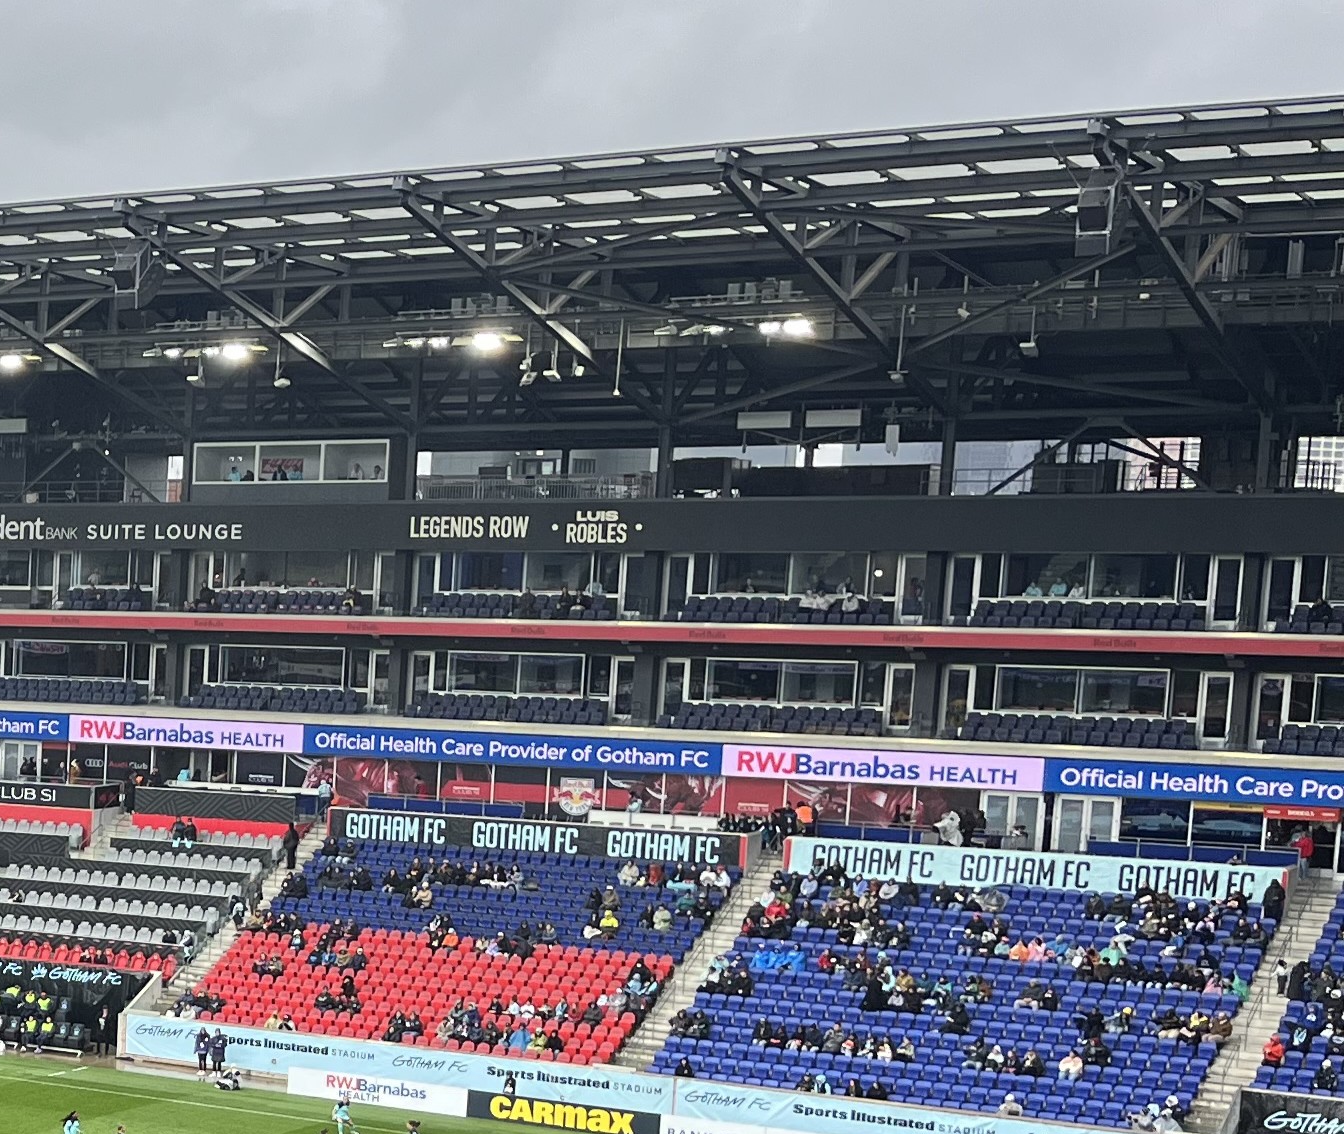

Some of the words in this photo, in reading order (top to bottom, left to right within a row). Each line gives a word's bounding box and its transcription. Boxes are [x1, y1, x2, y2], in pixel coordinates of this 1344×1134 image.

[409, 516, 484, 539] LEGENDS
[489, 515, 529, 539] ROW
[576, 510, 619, 522] LUIS
[46, 527, 78, 541] BANK
[86, 523, 146, 541] SUITE
[154, 523, 243, 541] LOUNGE
[565, 523, 627, 544] ROBLES
[80, 719, 214, 745] RWJBarnabas
[221, 731, 284, 748] HEALTH
[314, 733, 375, 751] Official
[380, 736, 437, 755] Health
[441, 740, 484, 757] Care
[488, 741, 568, 762] Provider
[571, 745, 592, 762] of
[596, 747, 675, 768] Gotham
[680, 751, 709, 768] FC
[737, 750, 920, 780] RWJBarnabas
[929, 765, 1017, 785] HEALTH
[40, 789, 56, 802] SI
[1060, 767, 1143, 790] Official
[1150, 771, 1229, 795] Health
[1235, 776, 1294, 798] Care
[346, 812, 419, 842] GOTHAM
[423, 818, 446, 844] FC
[472, 821, 550, 851] GOTHAM
[555, 827, 578, 854] FC
[607, 831, 690, 862] GOTHAM
[694, 835, 720, 863] FC
[812, 844, 901, 877] GOTHAM
[912, 850, 934, 877] FC
[960, 854, 1054, 887] GOTHAM
[1063, 861, 1090, 888] FC
[1119, 864, 1219, 897] GOTHAM
[1226, 871, 1255, 899] FC
[2, 962, 23, 976] FC
[136, 1024, 184, 1038] GOTHAM
[264, 1036, 329, 1056] Illustrated
[331, 1049, 375, 1061] STADIUM
[392, 1055, 446, 1072] GOTHAM
[448, 1059, 468, 1073] FC
[326, 1074, 427, 1100] RWJBarnabas
[487, 1065, 534, 1082] Sports
[536, 1069, 610, 1090] Illustrated
[612, 1083, 663, 1096] STADIUM
[338, 1089, 380, 1104] HEALTH
[685, 1090, 747, 1109] GOTHAM
[748, 1097, 772, 1112] FC
[792, 1102, 848, 1120] Sports
[850, 1109, 935, 1131] Illustrated
